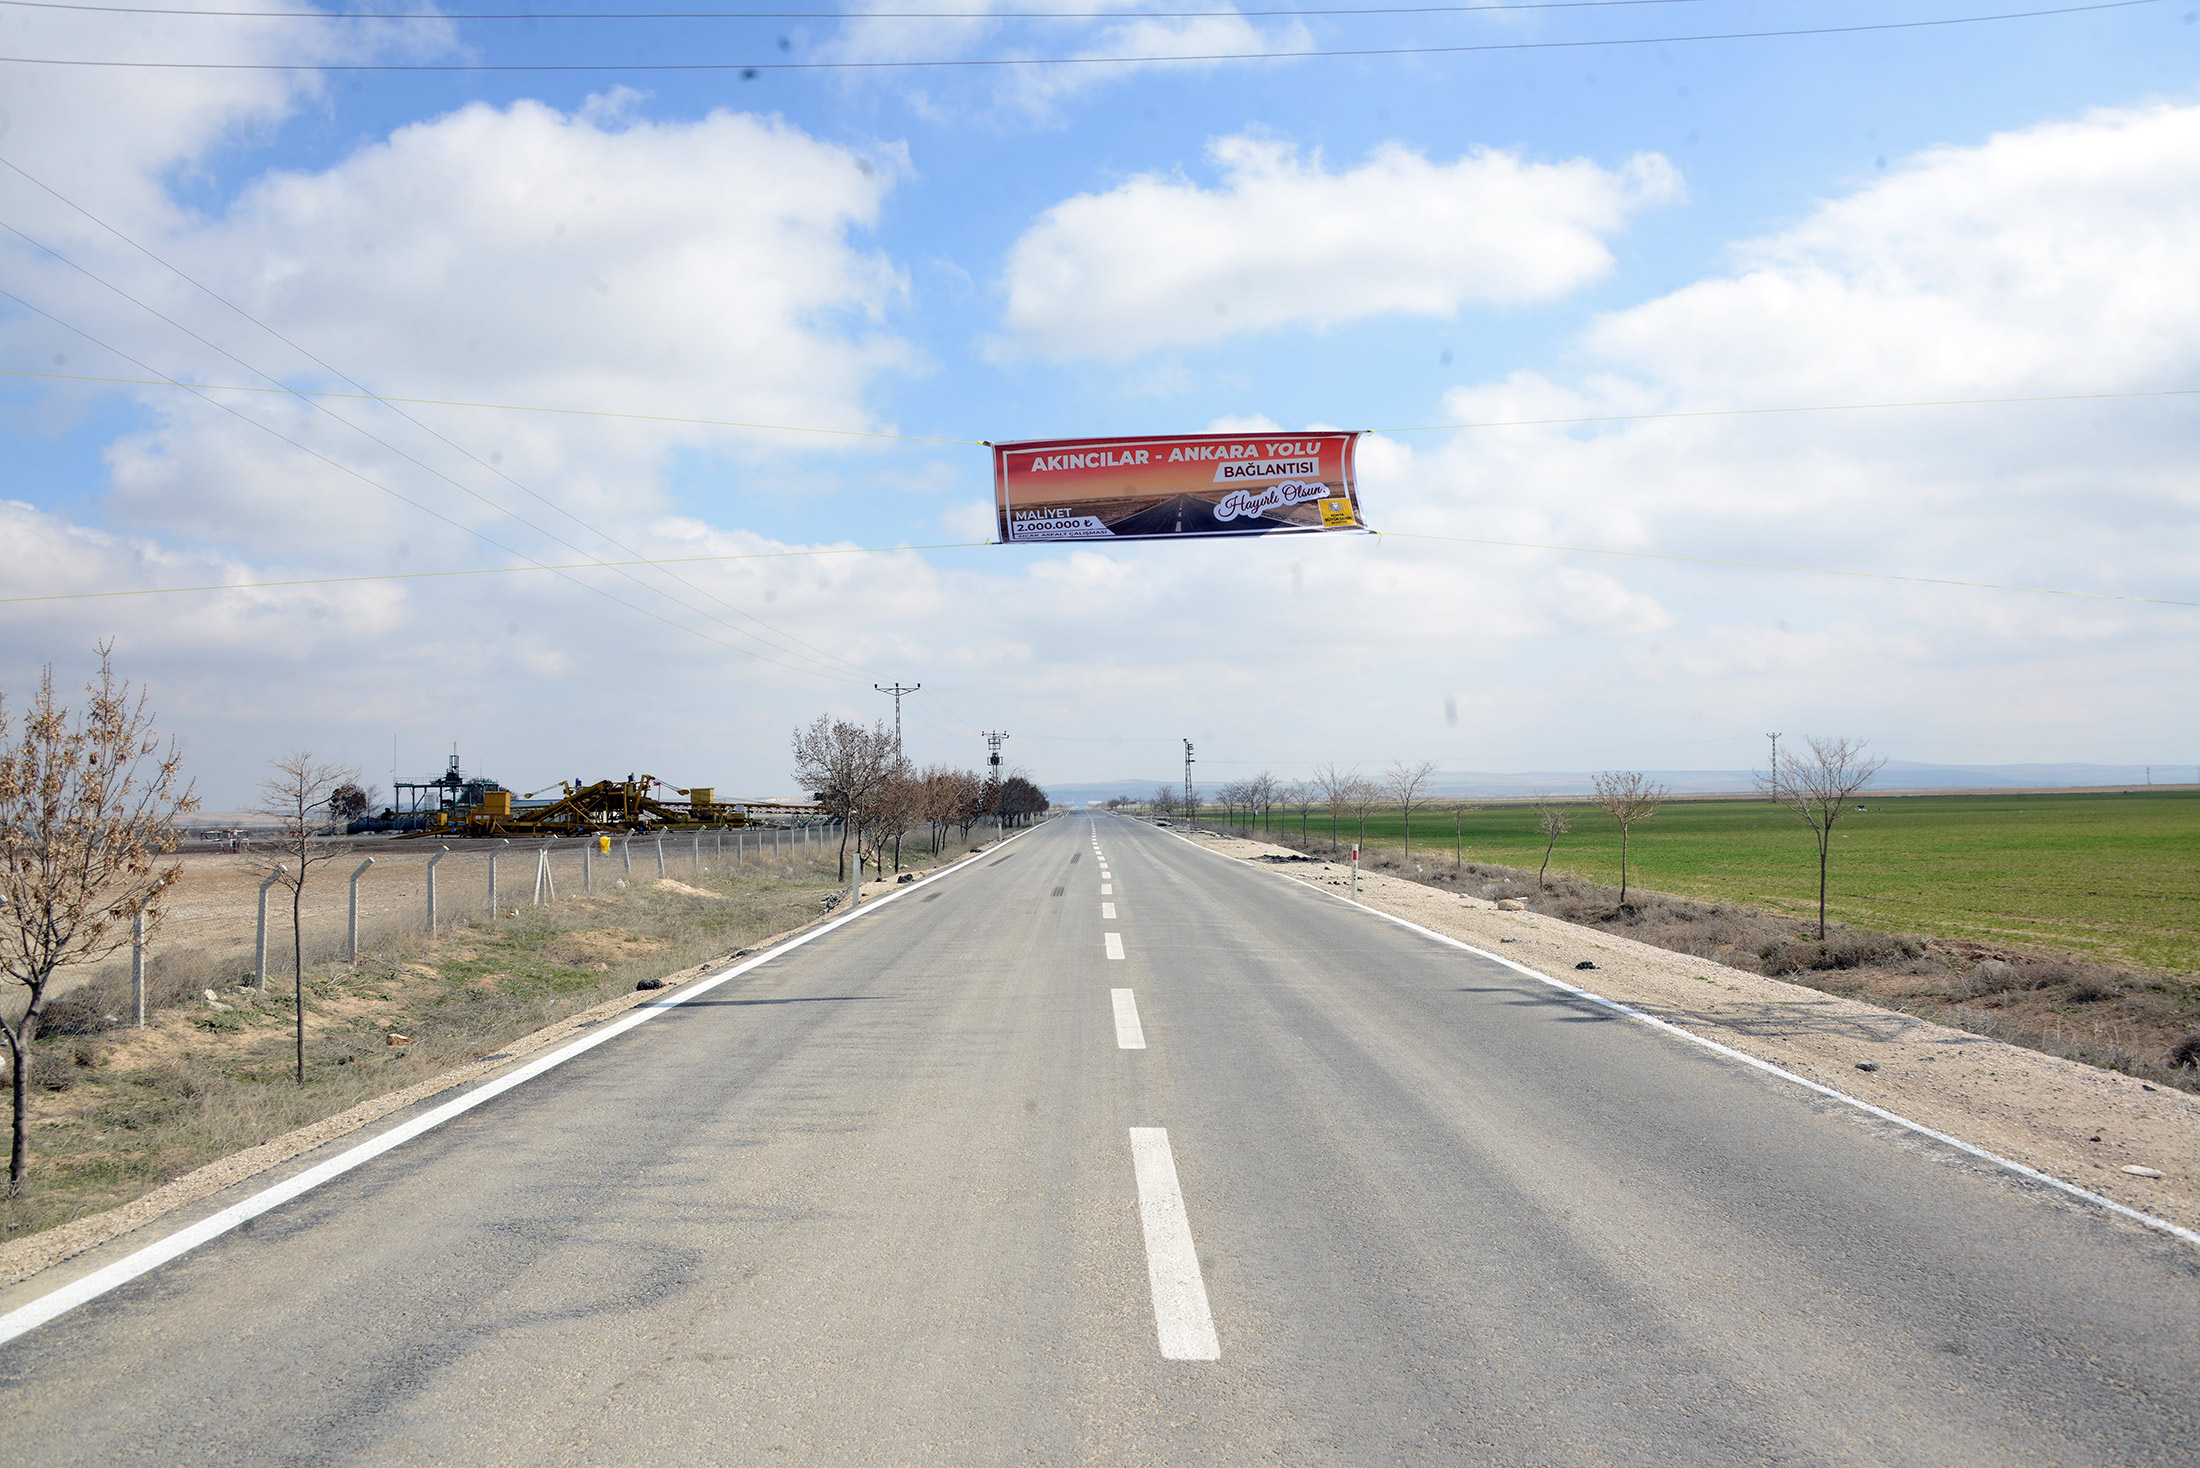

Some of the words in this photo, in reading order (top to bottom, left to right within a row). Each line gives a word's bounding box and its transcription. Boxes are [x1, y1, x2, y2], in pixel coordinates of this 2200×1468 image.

[1031, 450, 1149, 472] AKINCILAR
[1168, 443, 1259, 463] ANKARA
[1266, 442, 1321, 457] YOLU
[1224, 462, 1314, 478] BAĞLANTISI
[1218, 491, 1279, 517] Hayırlı
[1016, 507, 1072, 521] MALİYET
[1017, 520, 1080, 532] 2.000.000
